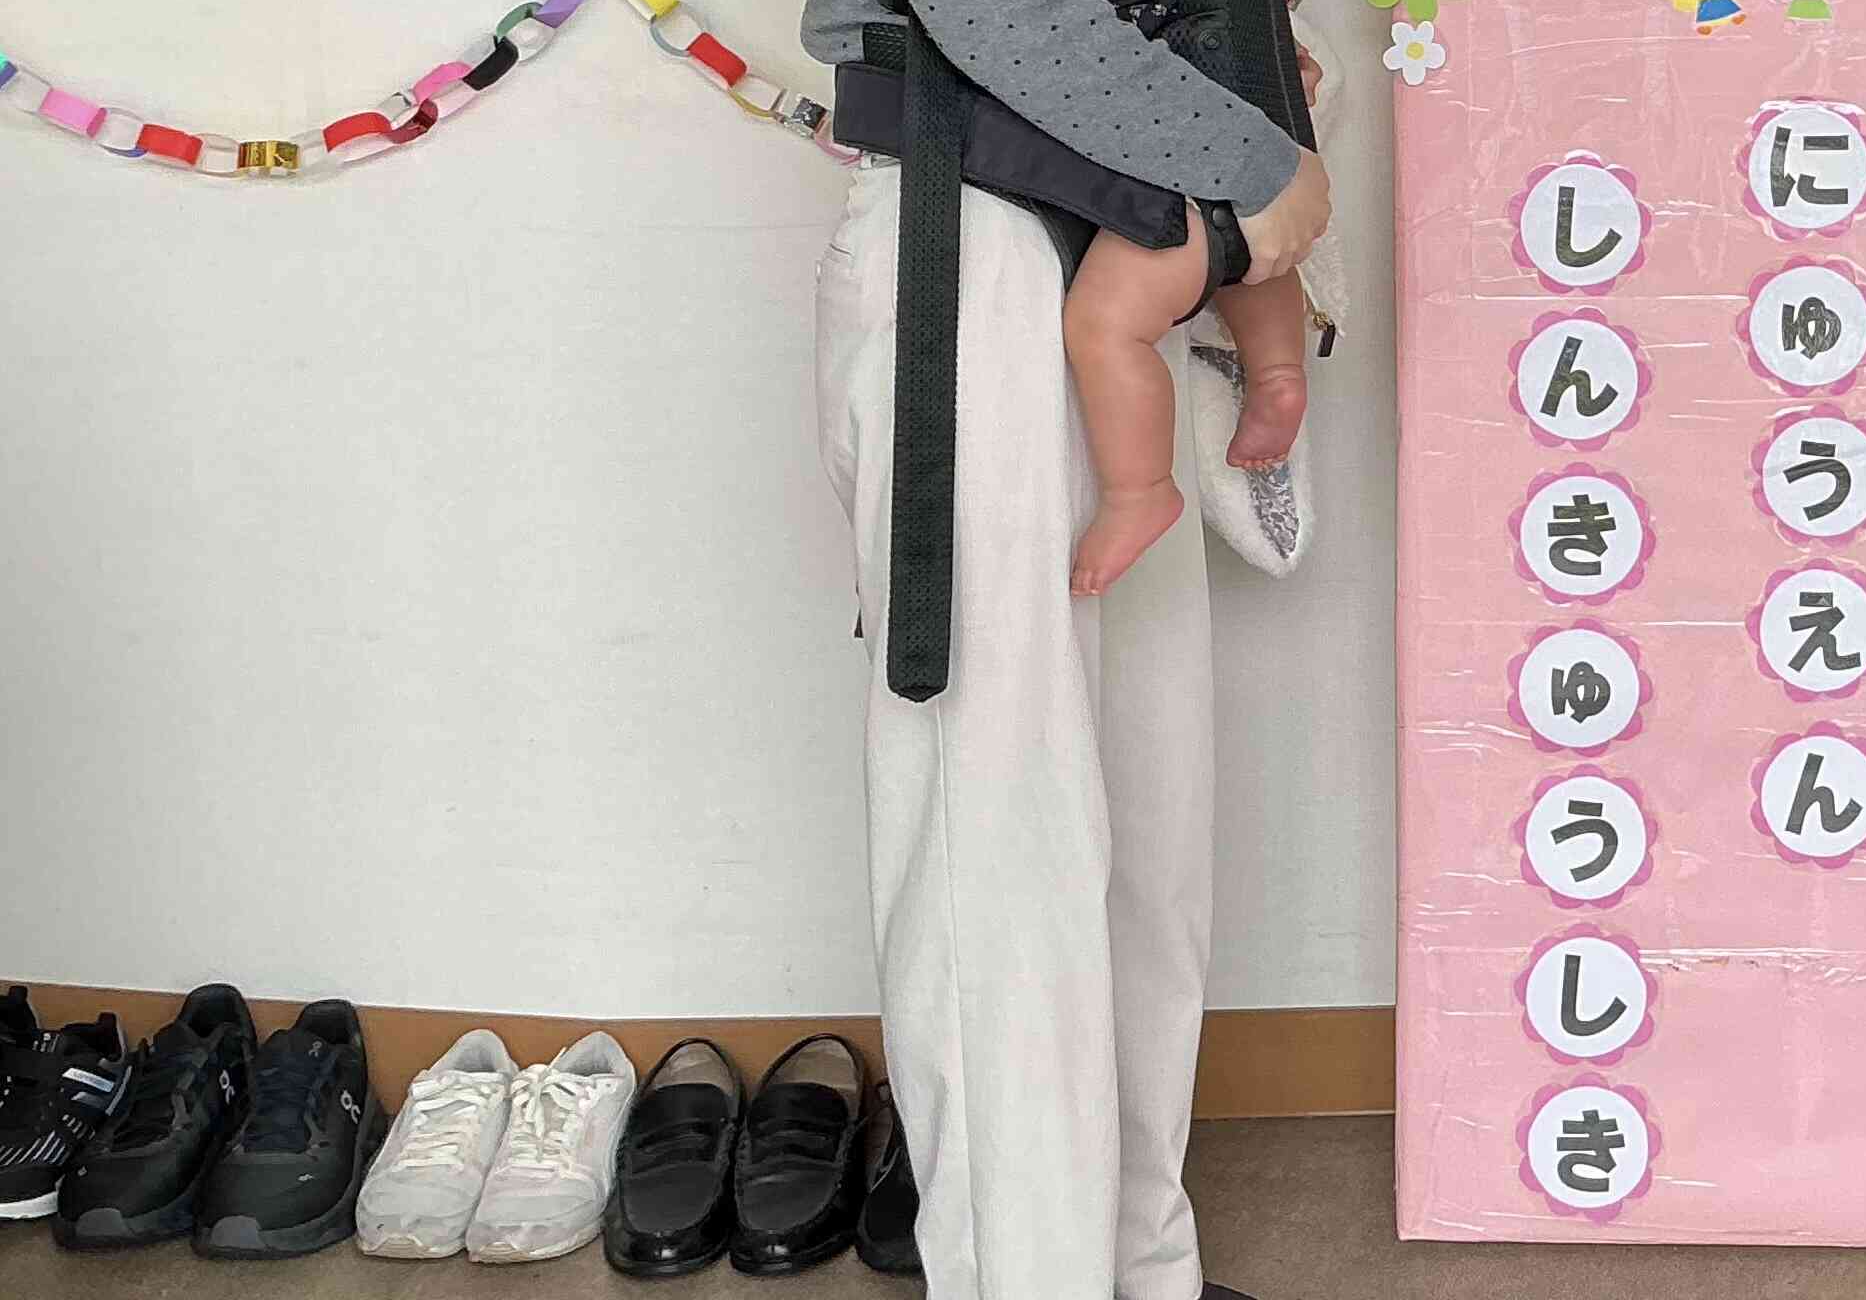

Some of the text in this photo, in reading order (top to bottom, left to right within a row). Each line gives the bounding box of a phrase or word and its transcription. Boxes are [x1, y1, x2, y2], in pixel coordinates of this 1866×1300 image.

[1540, 188, 1631, 1193] しんきゅうしき
[1773, 126, 1861, 834] にゅうえん
